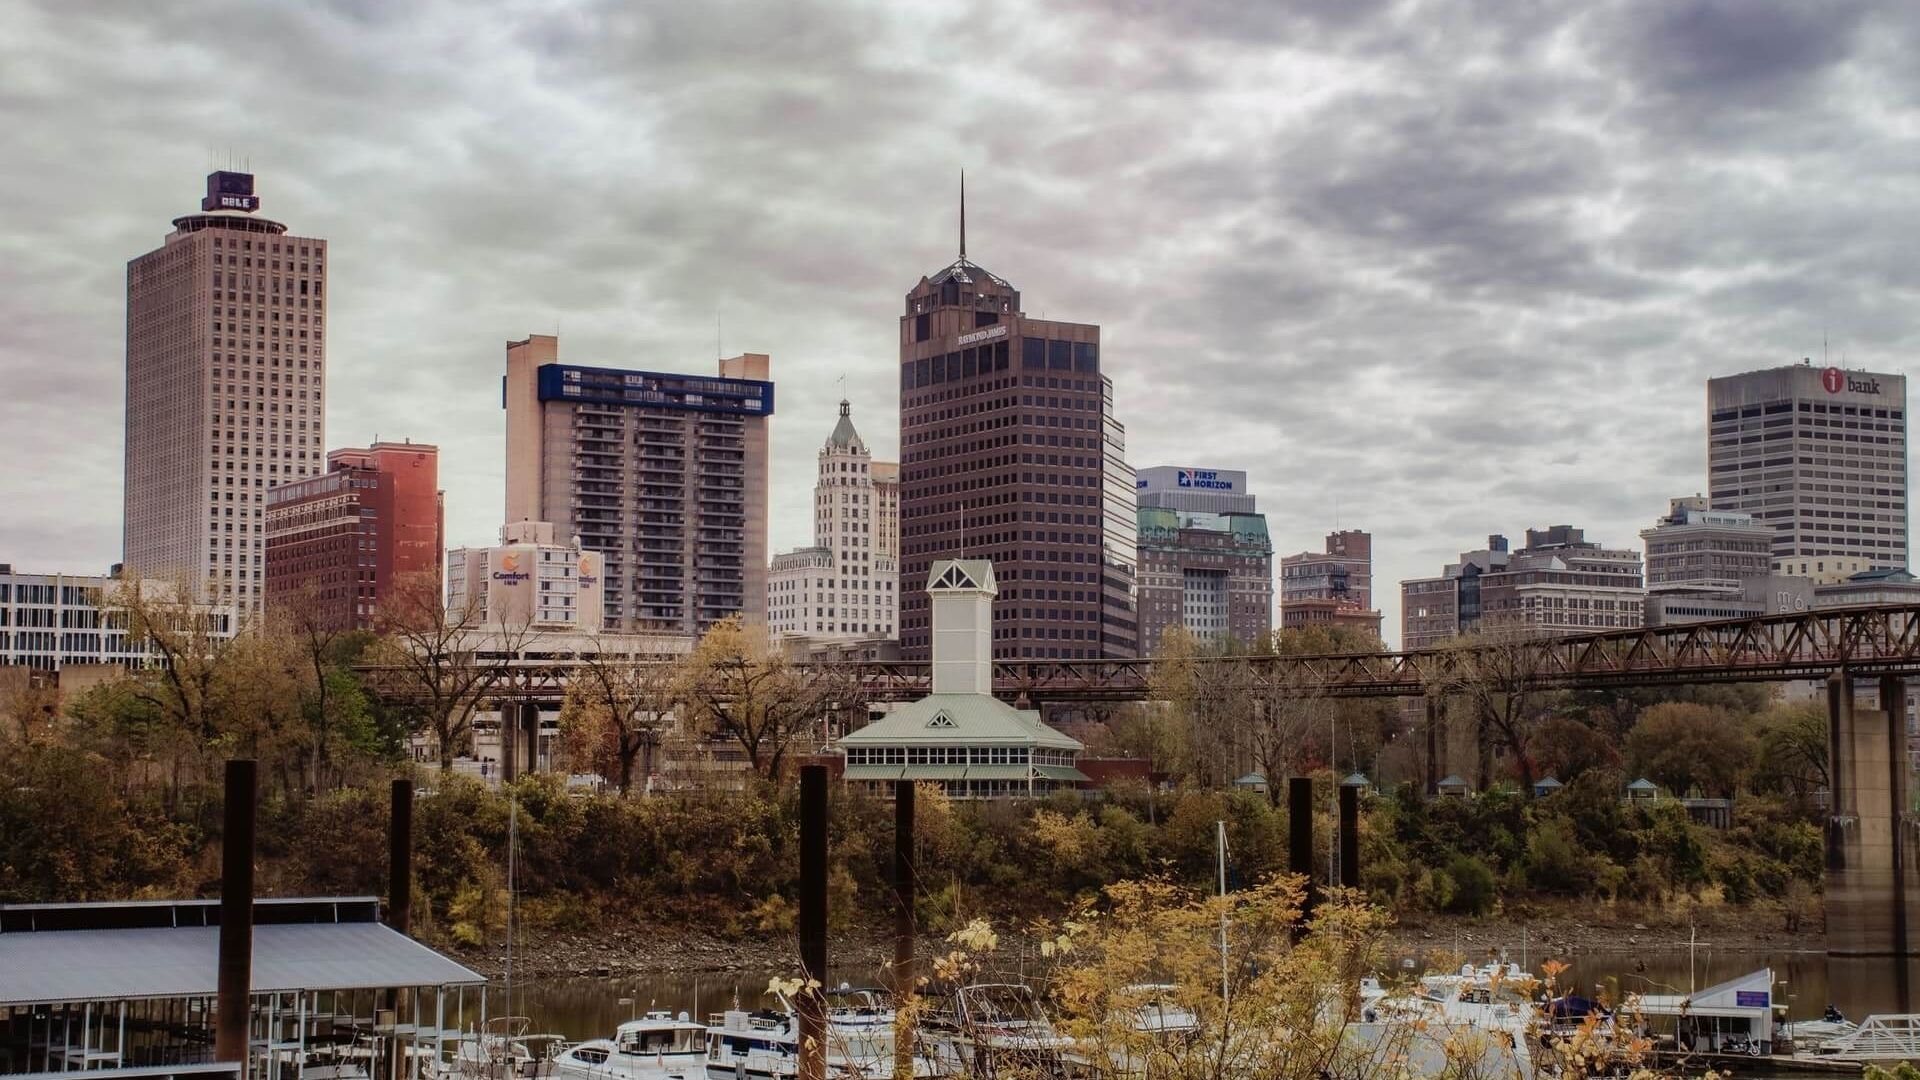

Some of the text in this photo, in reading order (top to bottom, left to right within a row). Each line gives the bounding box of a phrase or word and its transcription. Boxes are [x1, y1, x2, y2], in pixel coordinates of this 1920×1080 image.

[1847, 376, 1880, 394] bank
[1193, 471, 1217, 480] FIRST
[1194, 480, 1232, 490] HORIZON
[493, 571, 529, 580] Comfort
